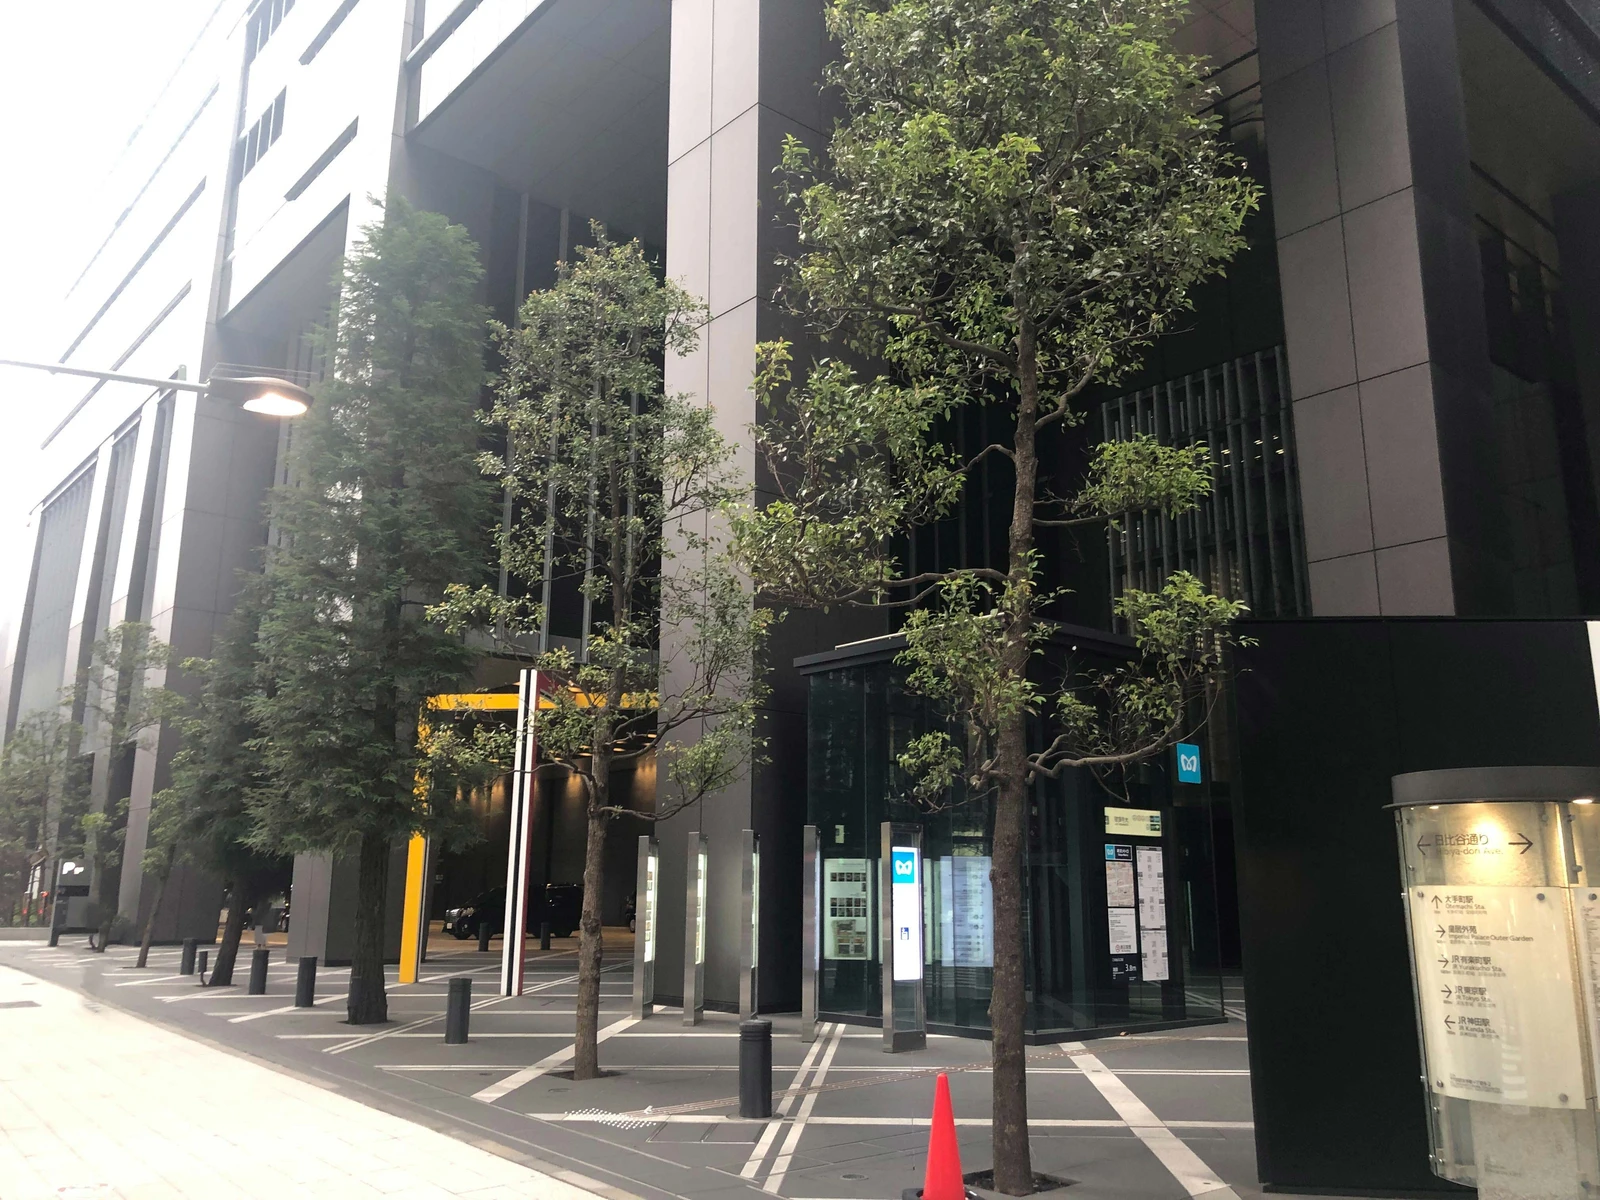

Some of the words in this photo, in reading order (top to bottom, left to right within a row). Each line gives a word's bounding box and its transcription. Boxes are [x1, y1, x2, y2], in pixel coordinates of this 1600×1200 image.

[1435, 834, 1489, 846] 日比谷通り
[1445, 895, 1474, 904] 大手町駅
